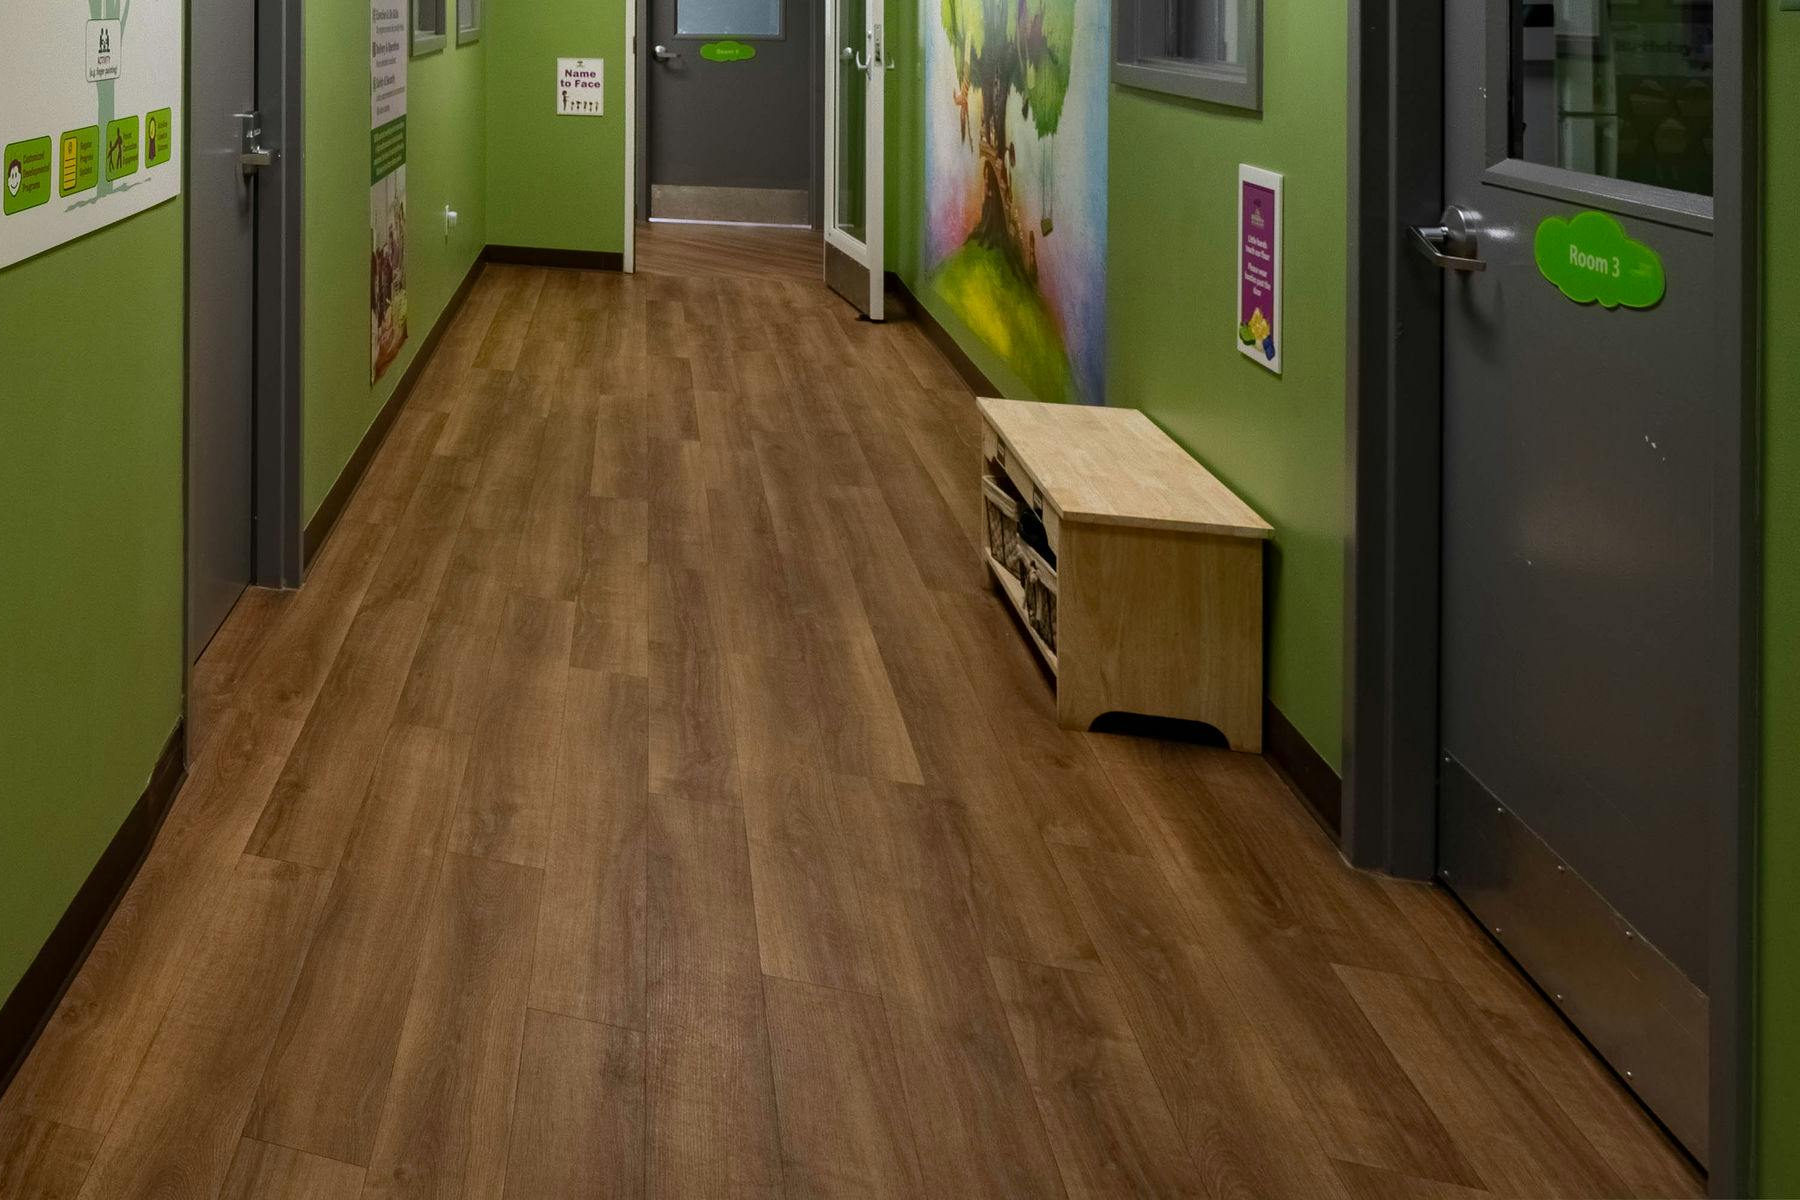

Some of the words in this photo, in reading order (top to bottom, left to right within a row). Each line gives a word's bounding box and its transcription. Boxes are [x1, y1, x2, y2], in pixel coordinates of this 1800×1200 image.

[564, 69, 596, 80] Name
[560, 79, 572, 88] to
[574, 80, 601, 89] Face
[1570, 244, 1608, 275] Room
[1612, 256, 1620, 278] 3
